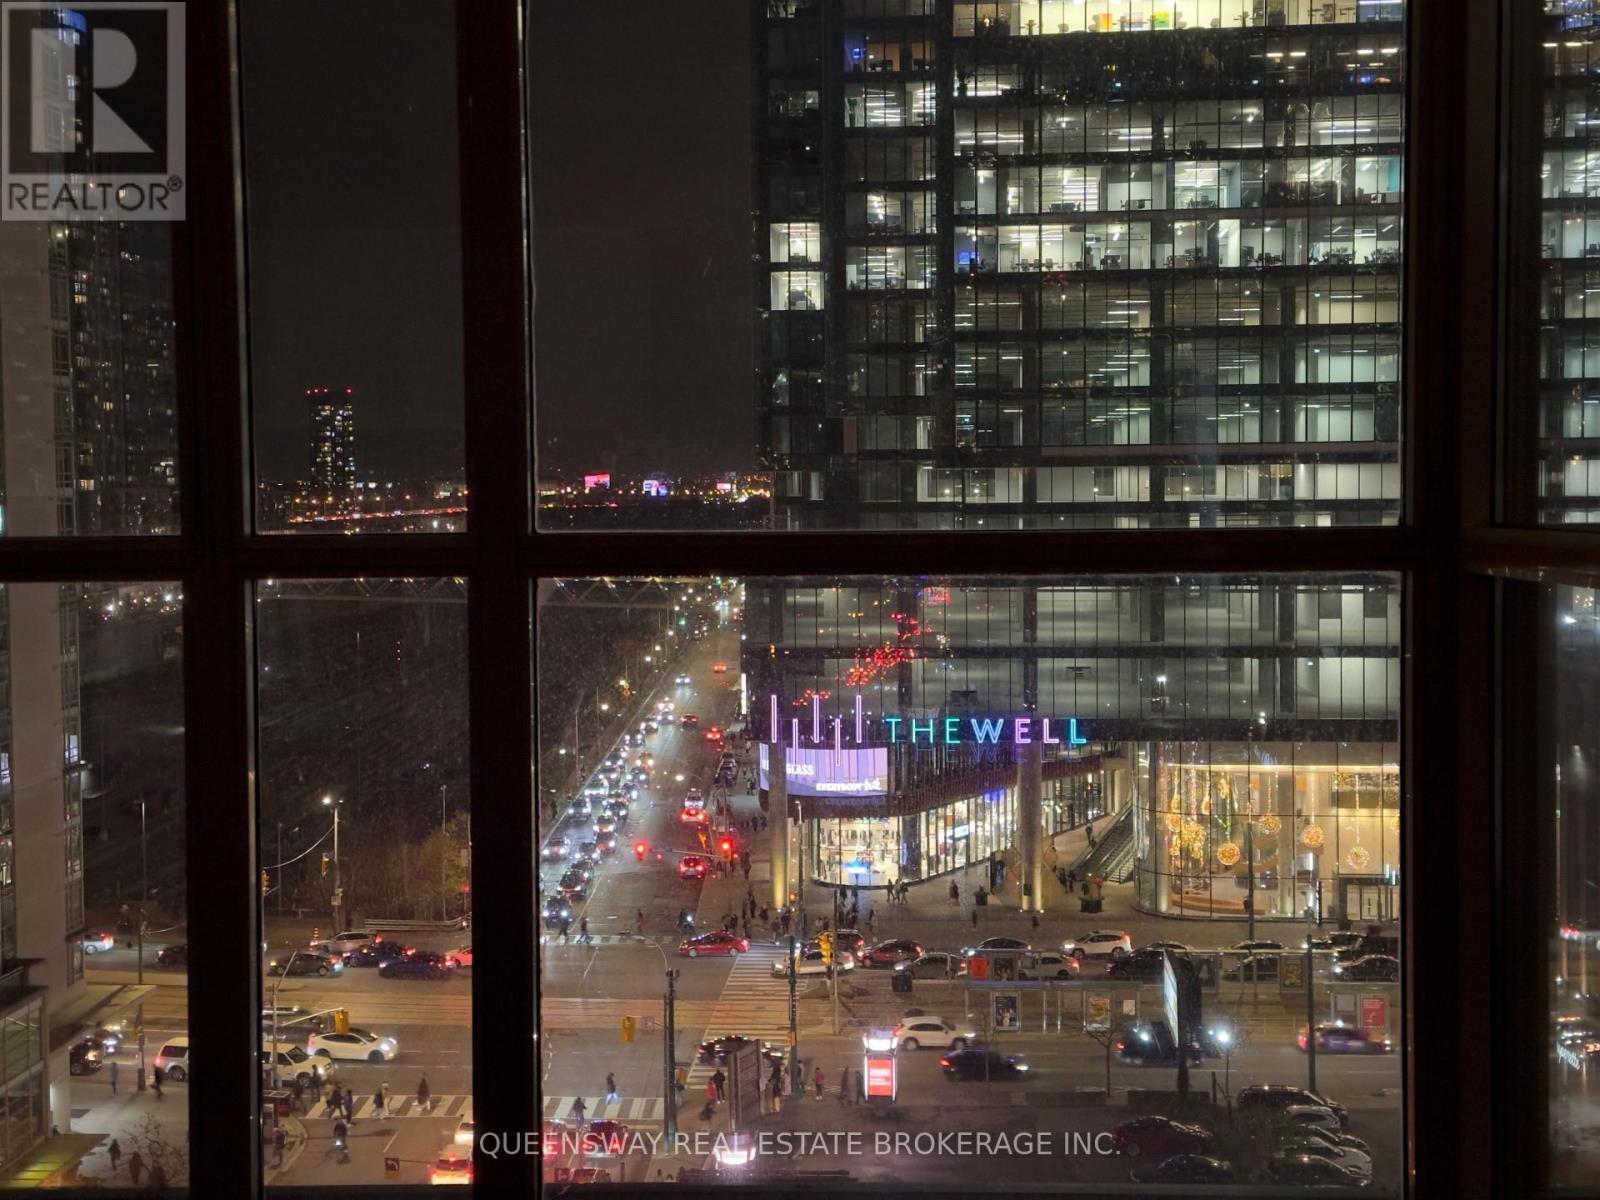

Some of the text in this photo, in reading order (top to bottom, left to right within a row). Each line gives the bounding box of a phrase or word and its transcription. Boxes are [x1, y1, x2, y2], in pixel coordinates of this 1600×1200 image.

[885, 718, 1087, 744] THE WELL
[785, 763, 815, 776] GLASS
